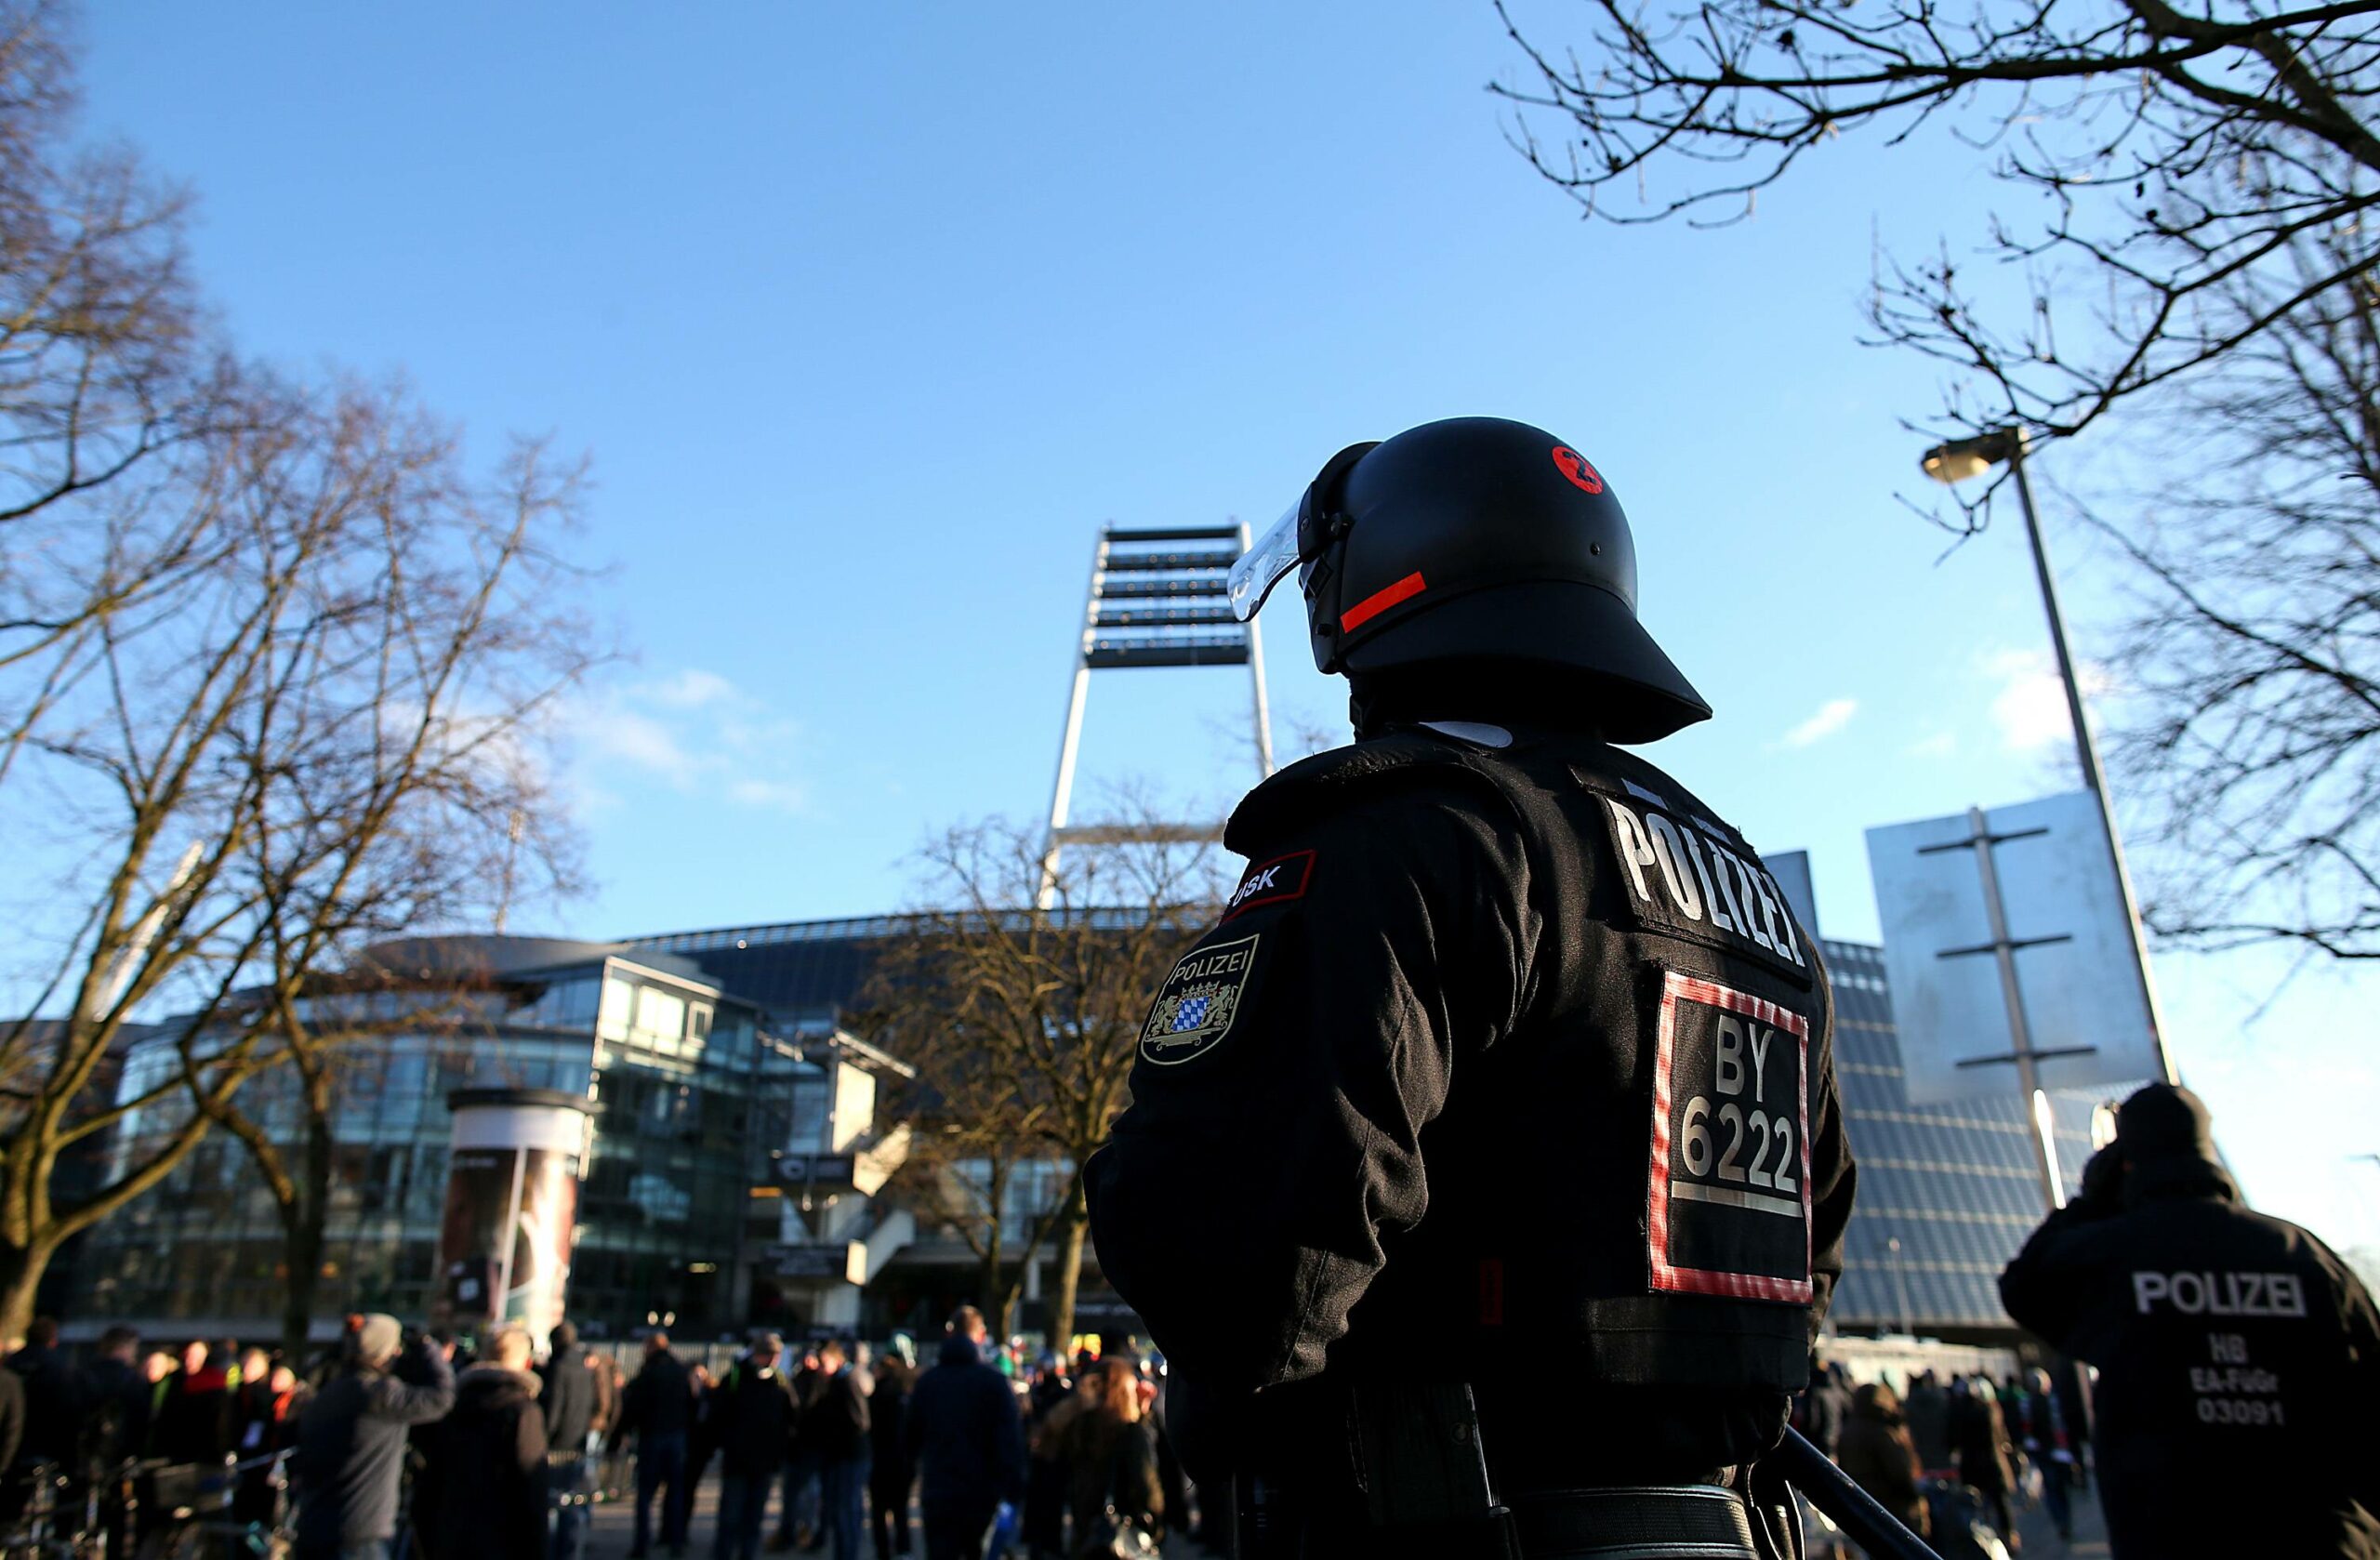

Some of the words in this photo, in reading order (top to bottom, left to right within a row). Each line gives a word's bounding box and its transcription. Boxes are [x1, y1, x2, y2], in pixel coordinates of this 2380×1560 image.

[1562, 451, 1597, 485] 2
[1606, 798, 1805, 968] POLIZEI
[1170, 950, 1250, 985] POLIZEI
[1716, 1014, 1774, 1104] BY
[1681, 1096, 1798, 1194] 6222
[2132, 1271, 2307, 1316] POLIZEI
[2207, 1332, 2248, 1363] HB
[2196, 1397, 2284, 1425] 03091
